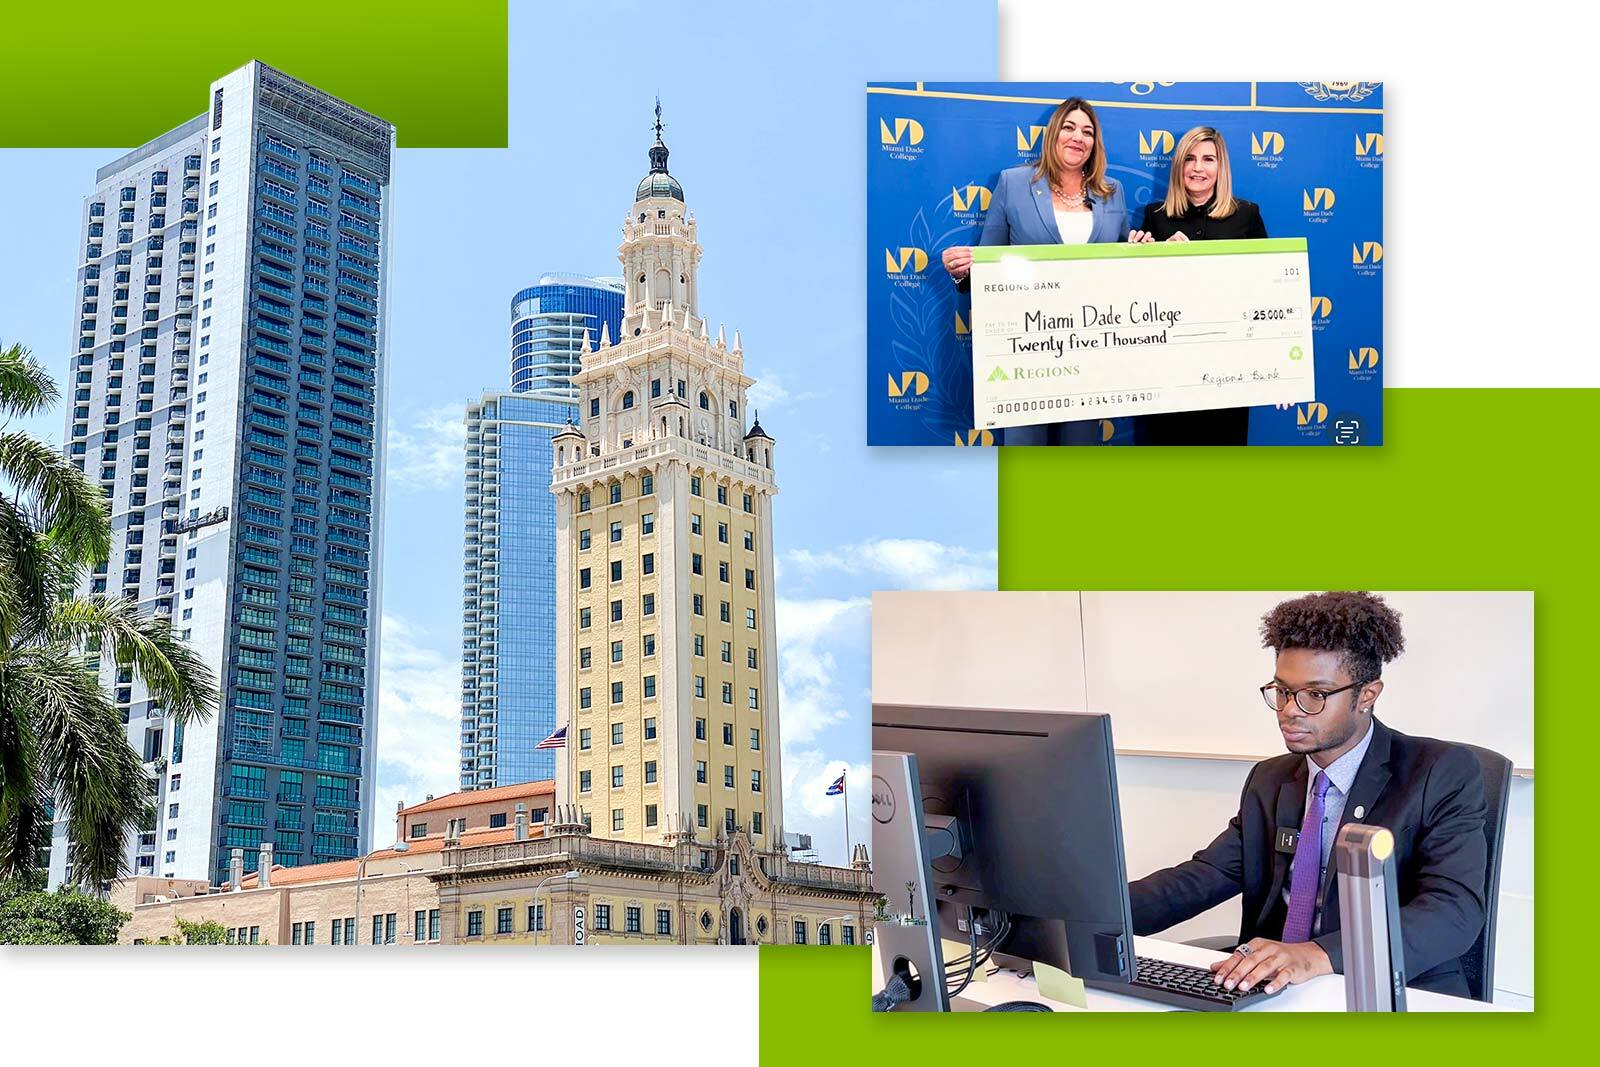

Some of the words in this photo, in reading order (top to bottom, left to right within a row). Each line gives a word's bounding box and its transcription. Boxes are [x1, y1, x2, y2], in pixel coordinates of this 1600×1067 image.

[882, 144, 904, 152] Miami
[890, 153, 917, 161] College
[894, 280, 920, 288] College
[984, 284, 1029, 292] REGIONS
[1034, 281, 1061, 290] BANK
[1025, 310, 1073, 332] Miami
[1082, 305, 1121, 327] Dade
[1130, 301, 1181, 328] College
[1007, 335, 1063, 358] Twenty
[1069, 333, 1099, 349] five
[1100, 330, 1167, 347] Thousand
